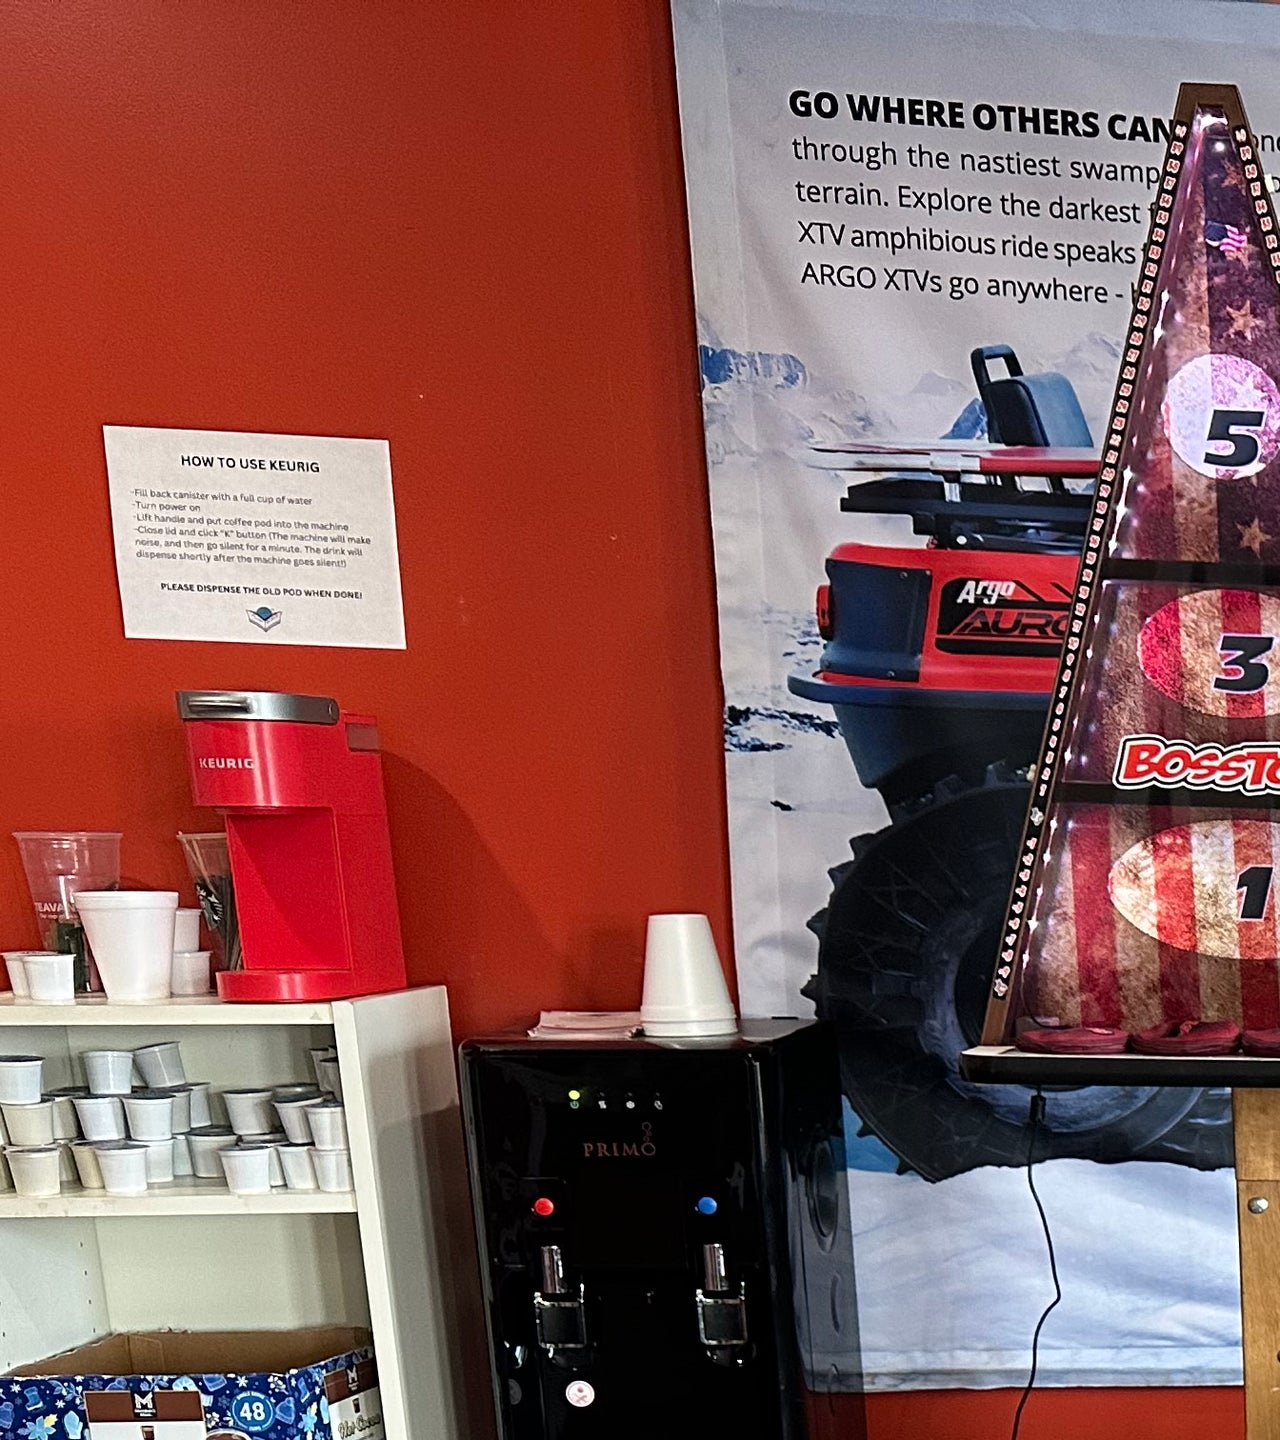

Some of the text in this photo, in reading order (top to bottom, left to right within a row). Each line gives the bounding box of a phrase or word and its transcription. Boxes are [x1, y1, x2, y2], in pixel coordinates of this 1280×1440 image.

[789, 90, 838, 119] GO
[846, 93, 965, 129] WHERE
[973, 103, 1099, 138] OTHERS
[791, 136, 896, 171] through
[906, 144, 948, 170] the
[960, 151, 1061, 178] nastiest
[794, 180, 888, 207] terrain.
[898, 185, 991, 216] Explore
[999, 192, 1040, 218] the
[1048, 194, 1140, 224] darkest
[797, 220, 844, 246] XTV
[850, 226, 995, 257] amphibious
[1001, 234, 1047, 260] ride
[1053, 240, 1134, 266] speaks
[800, 261, 875, 290] ARGO
[883, 268, 941, 294] XTVs
[948, 276, 978, 301] go
[986, 278, 1107, 304] anywhere
[1203, 409, 1265, 467] 5
[181, 455, 320, 472] HOW TO USE KEURIG
[956, 580, 1016, 605] Argo
[1213, 635, 1274, 693] 3
[199, 757, 255, 769] KEURIG
[1236, 866, 1273, 919] 1
[583, 1142, 656, 1157] PRIMO
[240, 1402, 265, 1420] 48
